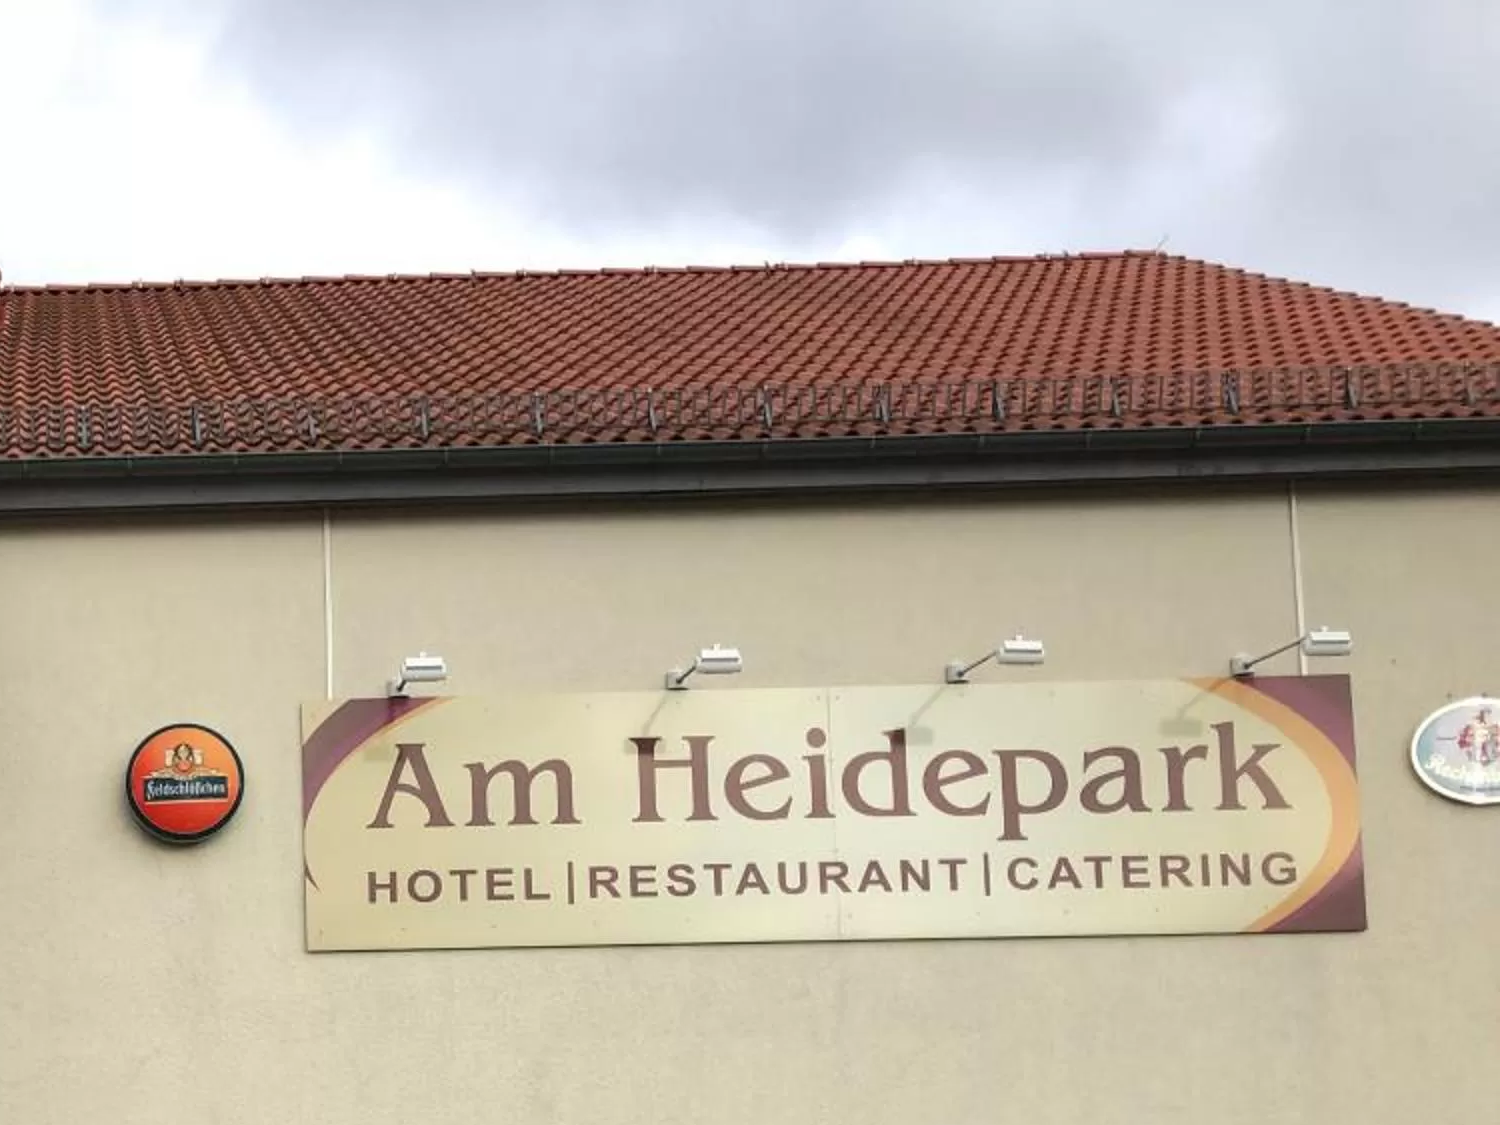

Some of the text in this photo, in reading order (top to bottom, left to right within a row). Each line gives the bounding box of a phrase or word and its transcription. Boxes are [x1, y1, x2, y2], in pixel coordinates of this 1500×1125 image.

[366, 721, 1293, 842] Am Heidepark
[367, 852, 1298, 904] HOTEL RESTAURANT CATERING
